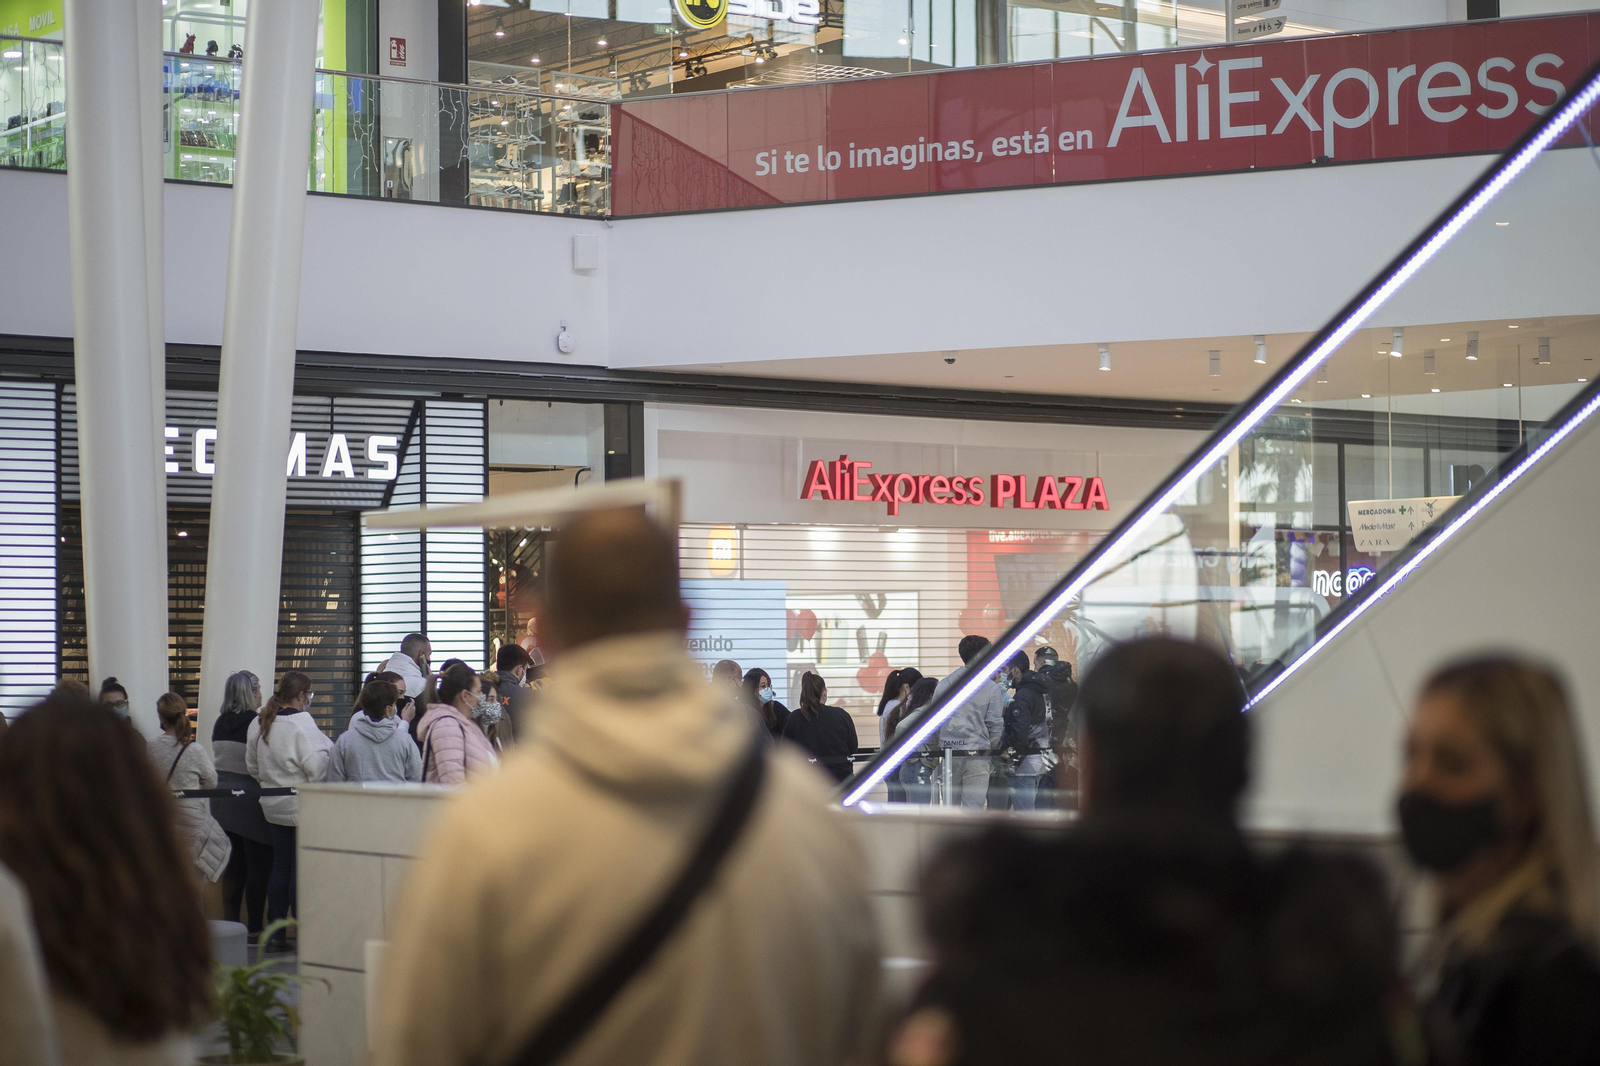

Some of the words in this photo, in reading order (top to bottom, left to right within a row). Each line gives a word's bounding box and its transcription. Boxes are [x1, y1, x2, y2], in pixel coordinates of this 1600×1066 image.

[755, 149, 777, 176] Si
[785, 151, 809, 174] te
[817, 145, 841, 171] lo
[850, 136, 983, 171] imaginas,
[992, 127, 1050, 157] está
[1058, 129, 1093, 151] en
[1107, 50, 1567, 158] AliExpress
[800, 455, 985, 516] AliExpress
[990, 474, 1110, 511] PLAZA
[1358, 508, 1396, 516] MERCADONA
[1360, 539, 1390, 547] ZARA
